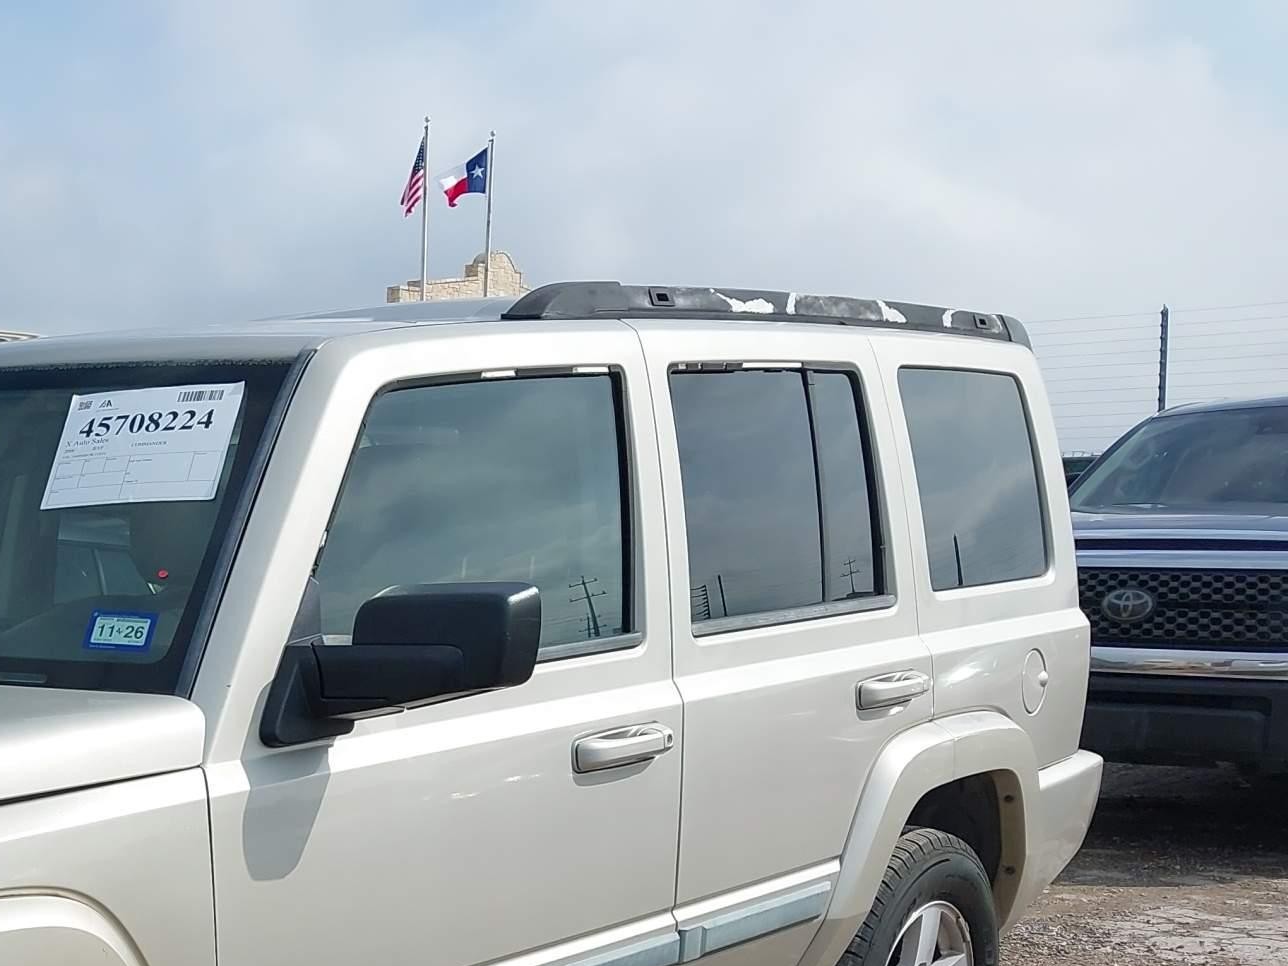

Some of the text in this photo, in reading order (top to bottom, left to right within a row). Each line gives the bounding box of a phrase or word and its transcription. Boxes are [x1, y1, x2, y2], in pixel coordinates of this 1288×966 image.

[79, 409, 214, 438] 45708224
[91, 436, 110, 446] Sales
[98, 623, 146, 640] 11 26
